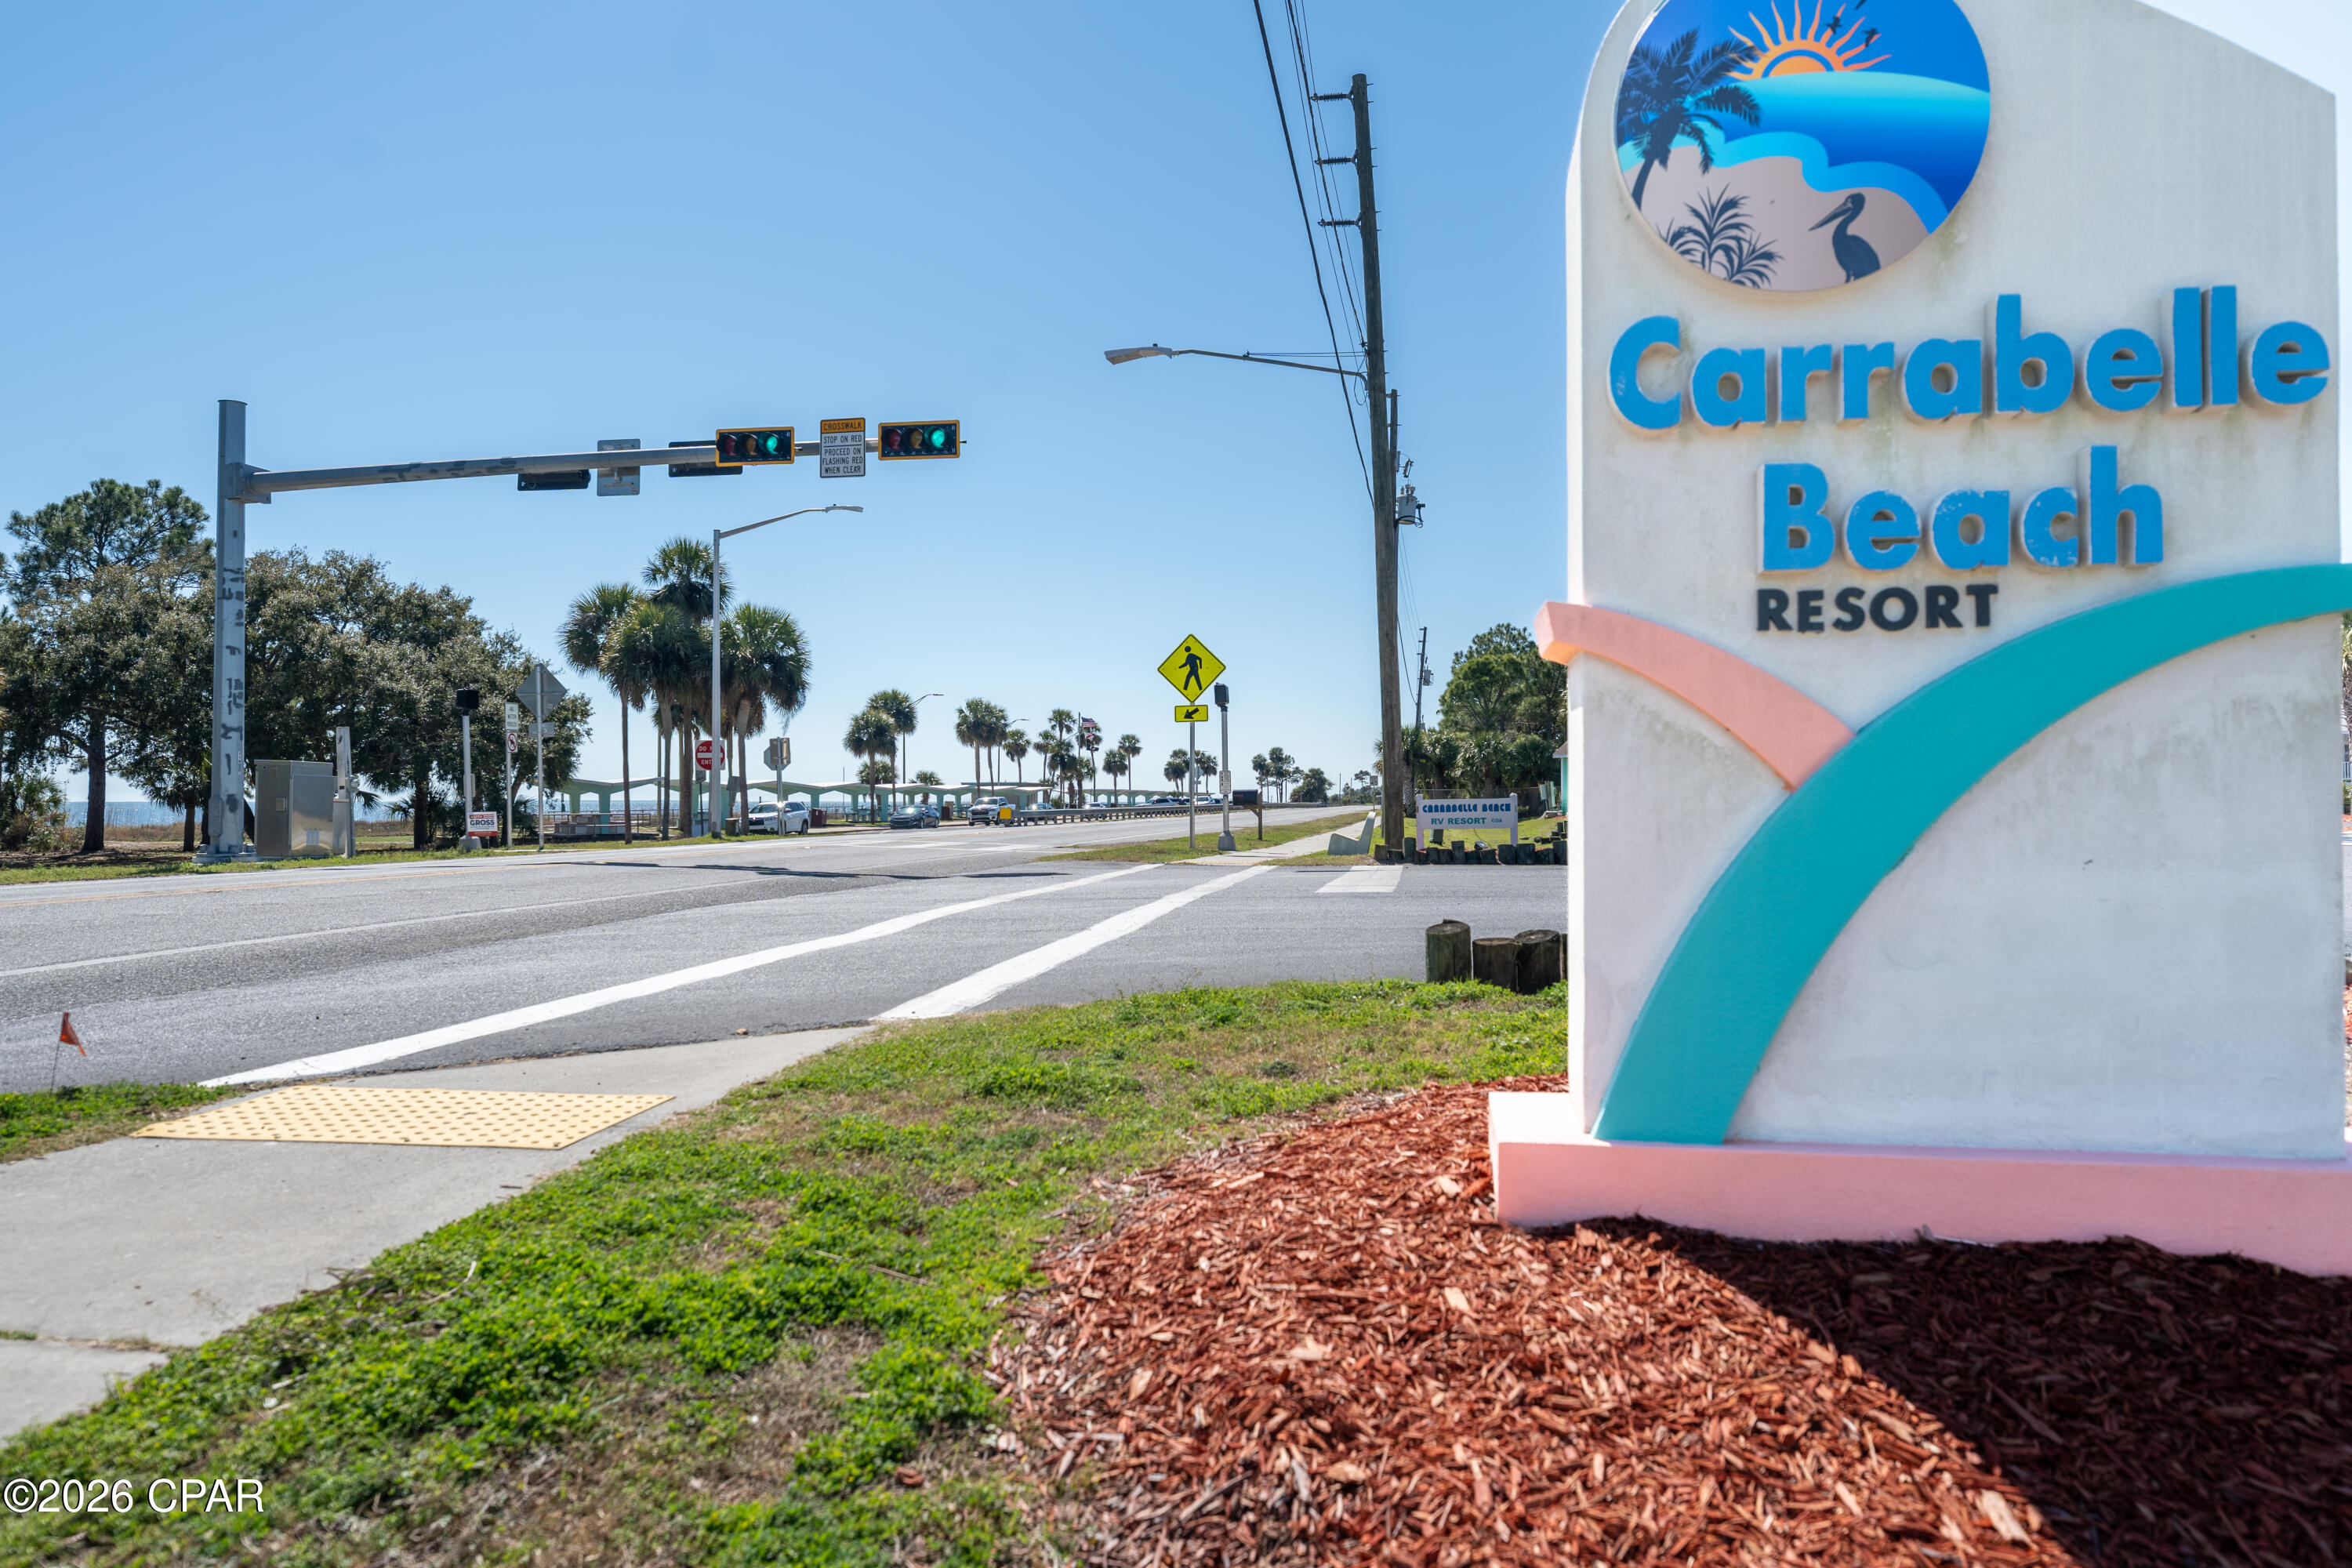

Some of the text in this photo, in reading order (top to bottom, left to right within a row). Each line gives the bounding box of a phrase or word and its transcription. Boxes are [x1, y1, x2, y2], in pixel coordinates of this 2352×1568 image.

[1609, 285, 2330, 433] Carrabelle
[823, 421, 862, 430] CROSSWALK
[823, 435, 837, 444] STOP
[824, 448, 850, 456] PROCEED
[822, 457, 849, 466] FLASHING
[824, 466, 840, 474] WHEN
[1757, 445, 2164, 573] Beach
[1757, 583, 1998, 633] RESORT
[1422, 803, 1511, 813] CARRABELLE BEACH
